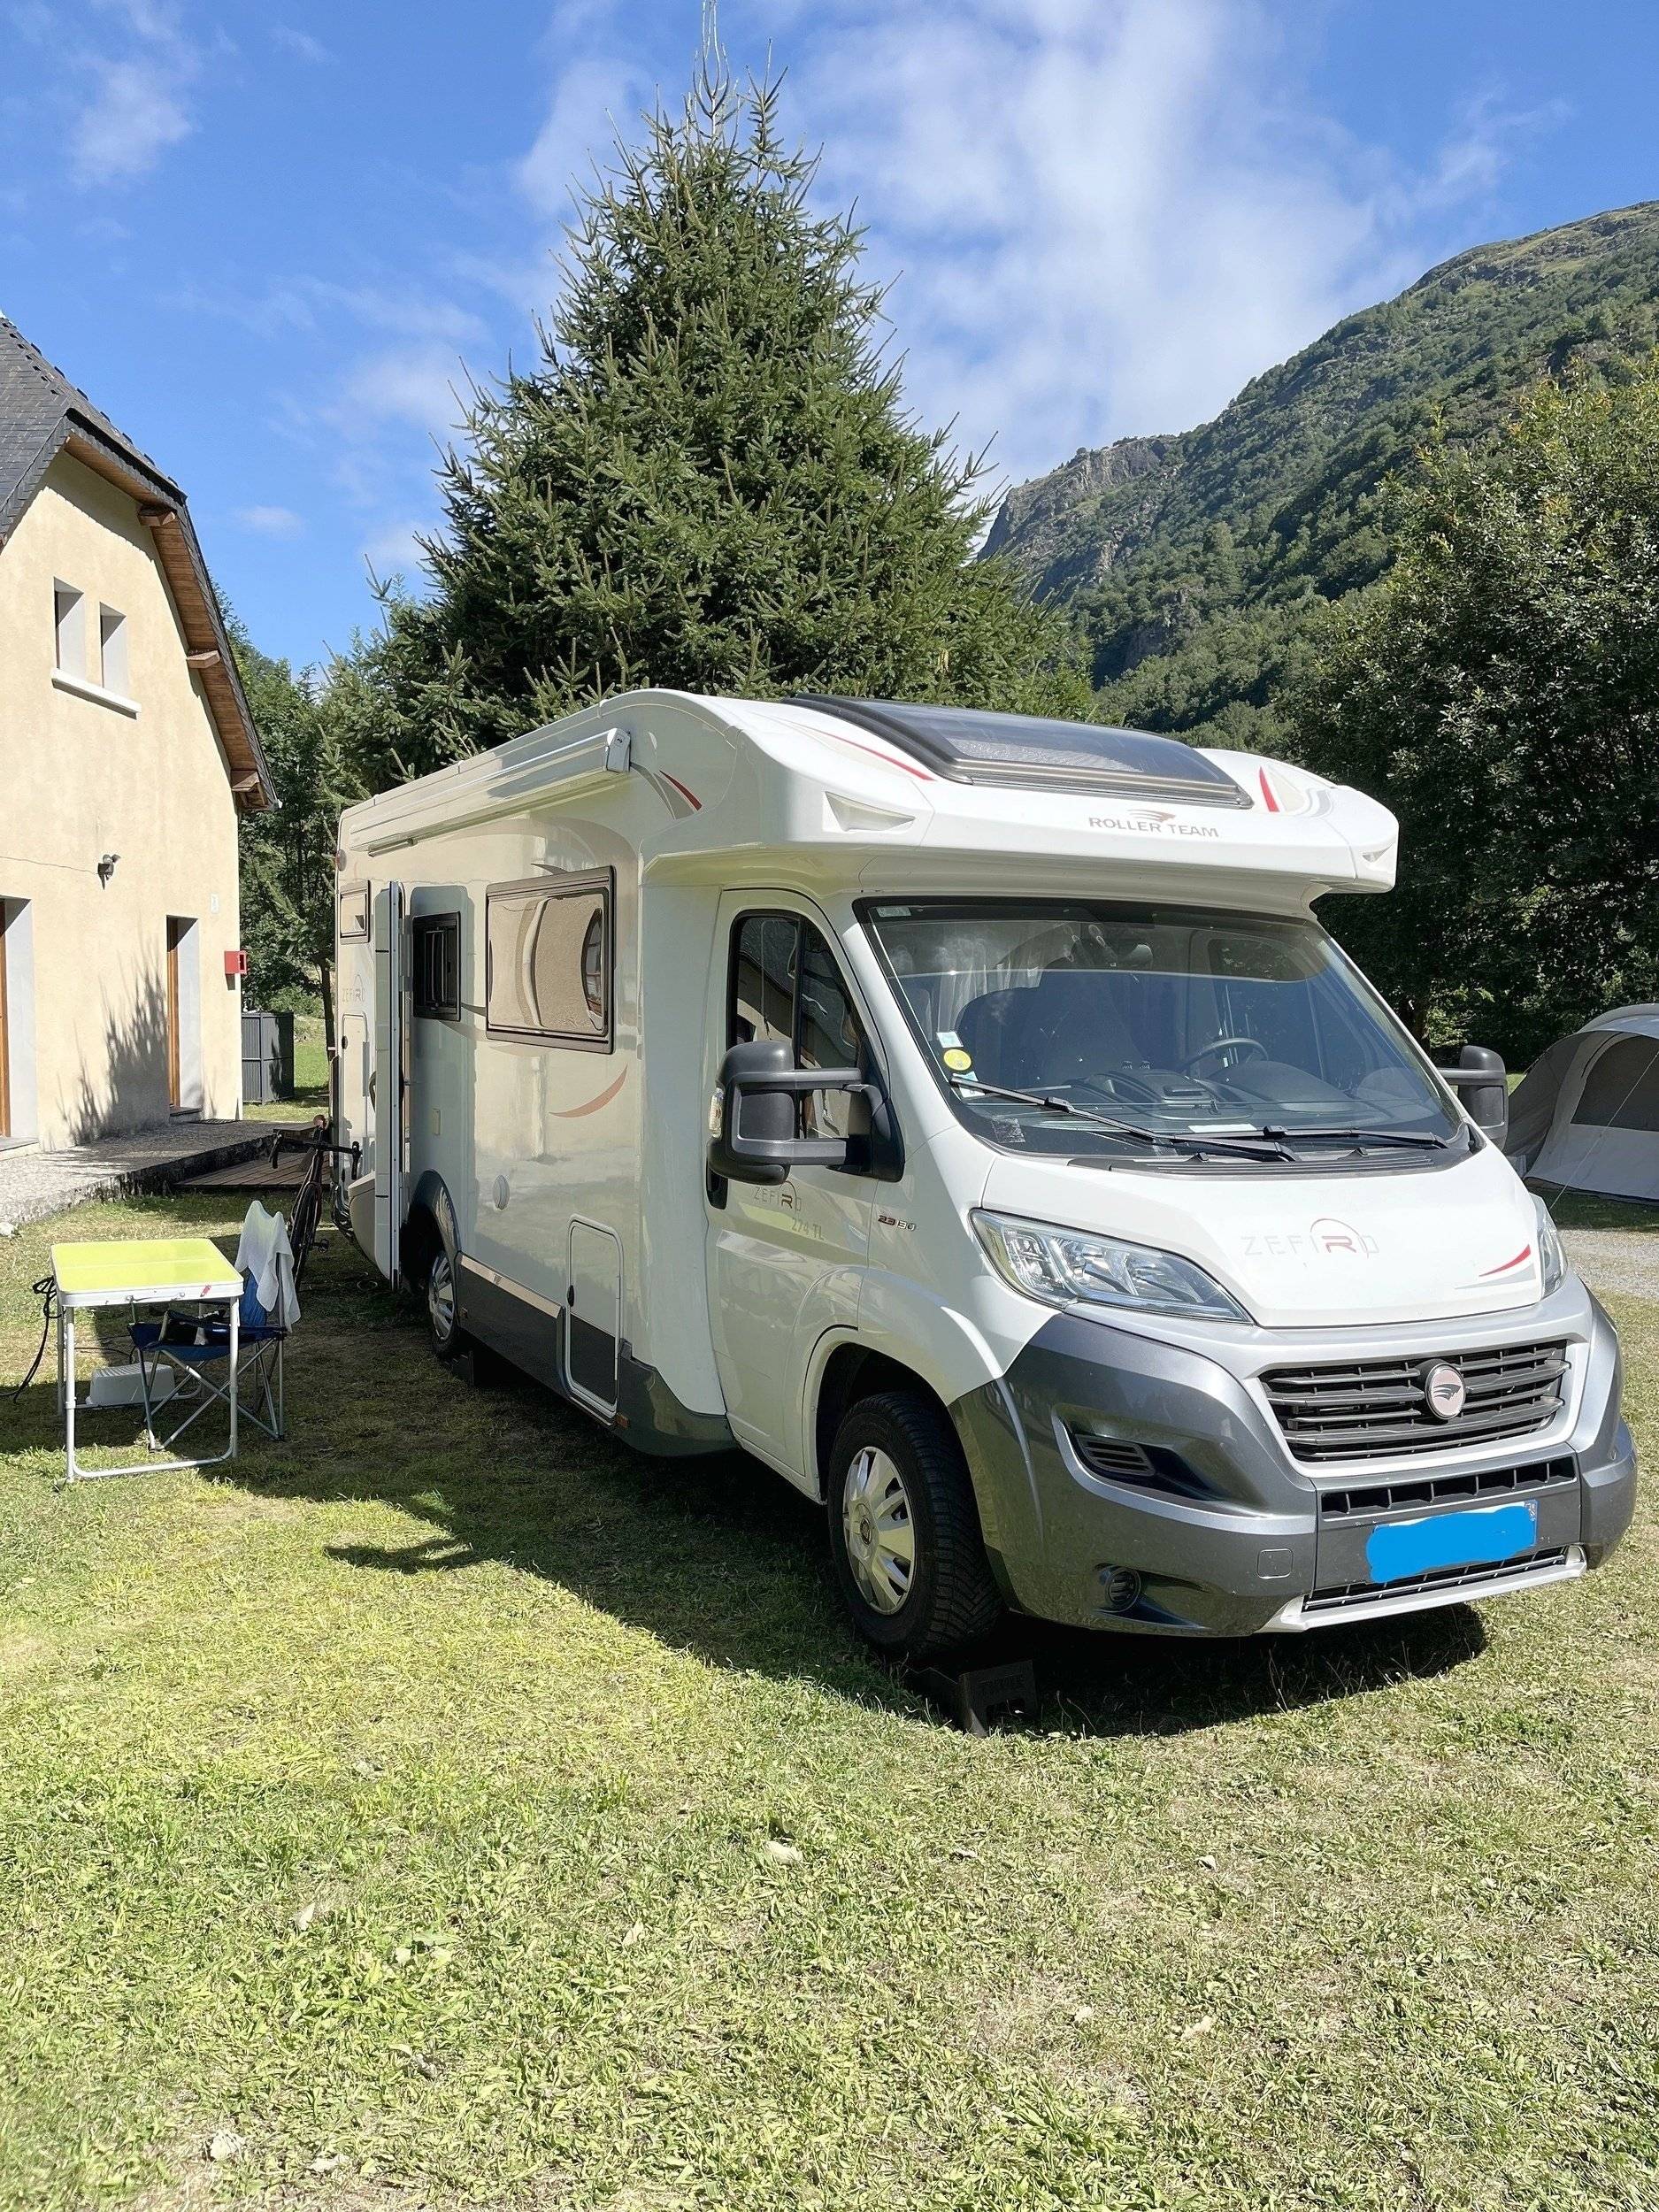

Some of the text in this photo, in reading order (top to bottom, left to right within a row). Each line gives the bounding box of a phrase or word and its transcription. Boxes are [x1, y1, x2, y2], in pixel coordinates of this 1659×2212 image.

[1088, 817, 1220, 837] ROLLER TEAM
[754, 1186, 803, 1211] ZEFIRO
[812, 1223, 825, 1240] TL
[1240, 1233, 1380, 1256] ZEFIRO
